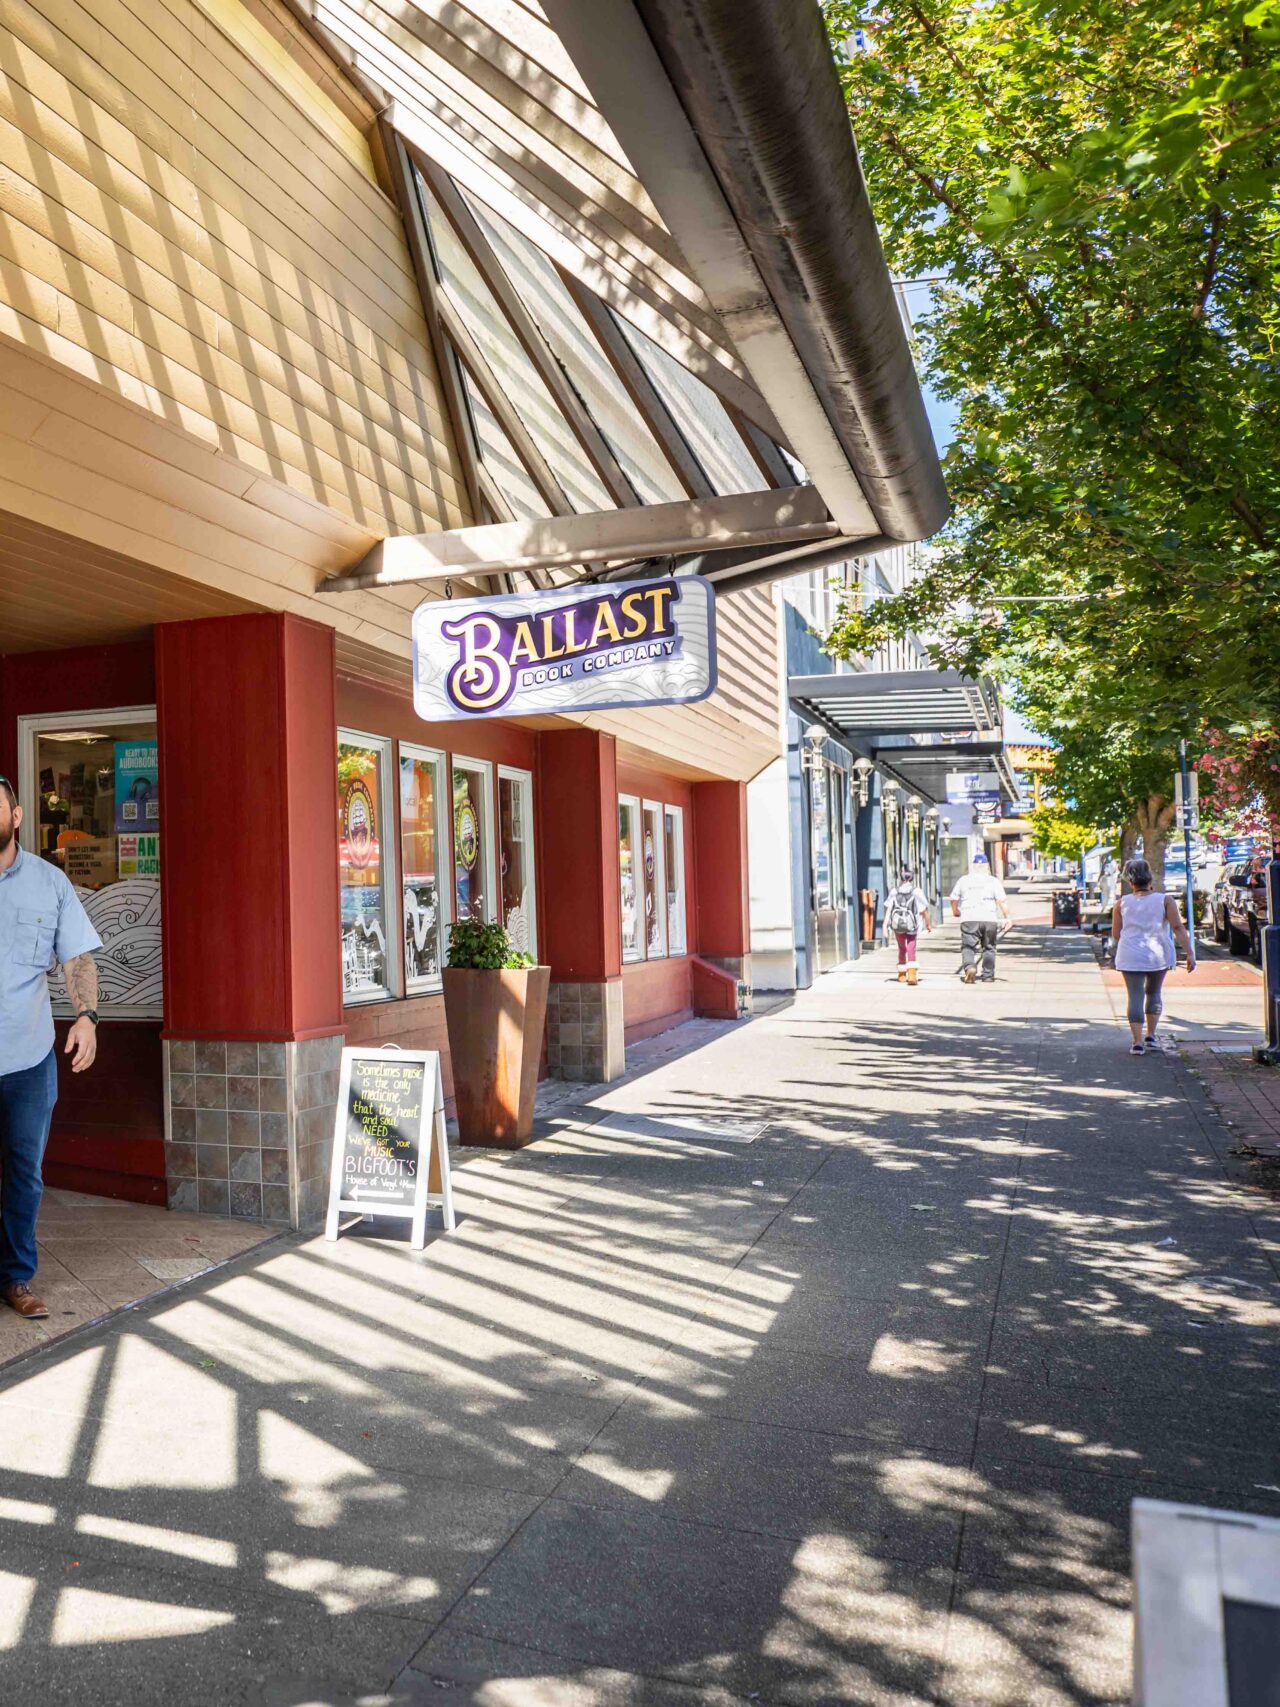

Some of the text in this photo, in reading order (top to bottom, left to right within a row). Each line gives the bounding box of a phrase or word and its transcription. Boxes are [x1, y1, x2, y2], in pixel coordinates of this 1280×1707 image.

[446, 586, 672, 708] BALLAST
[522, 639, 676, 688] BOOK COMPANY
[138, 837, 160, 857] AN
[356, 1061, 424, 1080] Sometimes music
[362, 1077, 412, 1096] is the only
[361, 1089, 401, 1103] medicine
[353, 1101, 420, 1119] that the heart
[362, 1115, 399, 1128] and soul
[362, 1124, 388, 1137] NEED
[363, 1146, 395, 1158] MUSIC
[376, 1138, 390, 1147] GOT
[395, 1140, 411, 1149] YOUR
[345, 1156, 416, 1177] BIGFOOT'S
[346, 1174, 369, 1186] House
[370, 1176, 380, 1187] of
